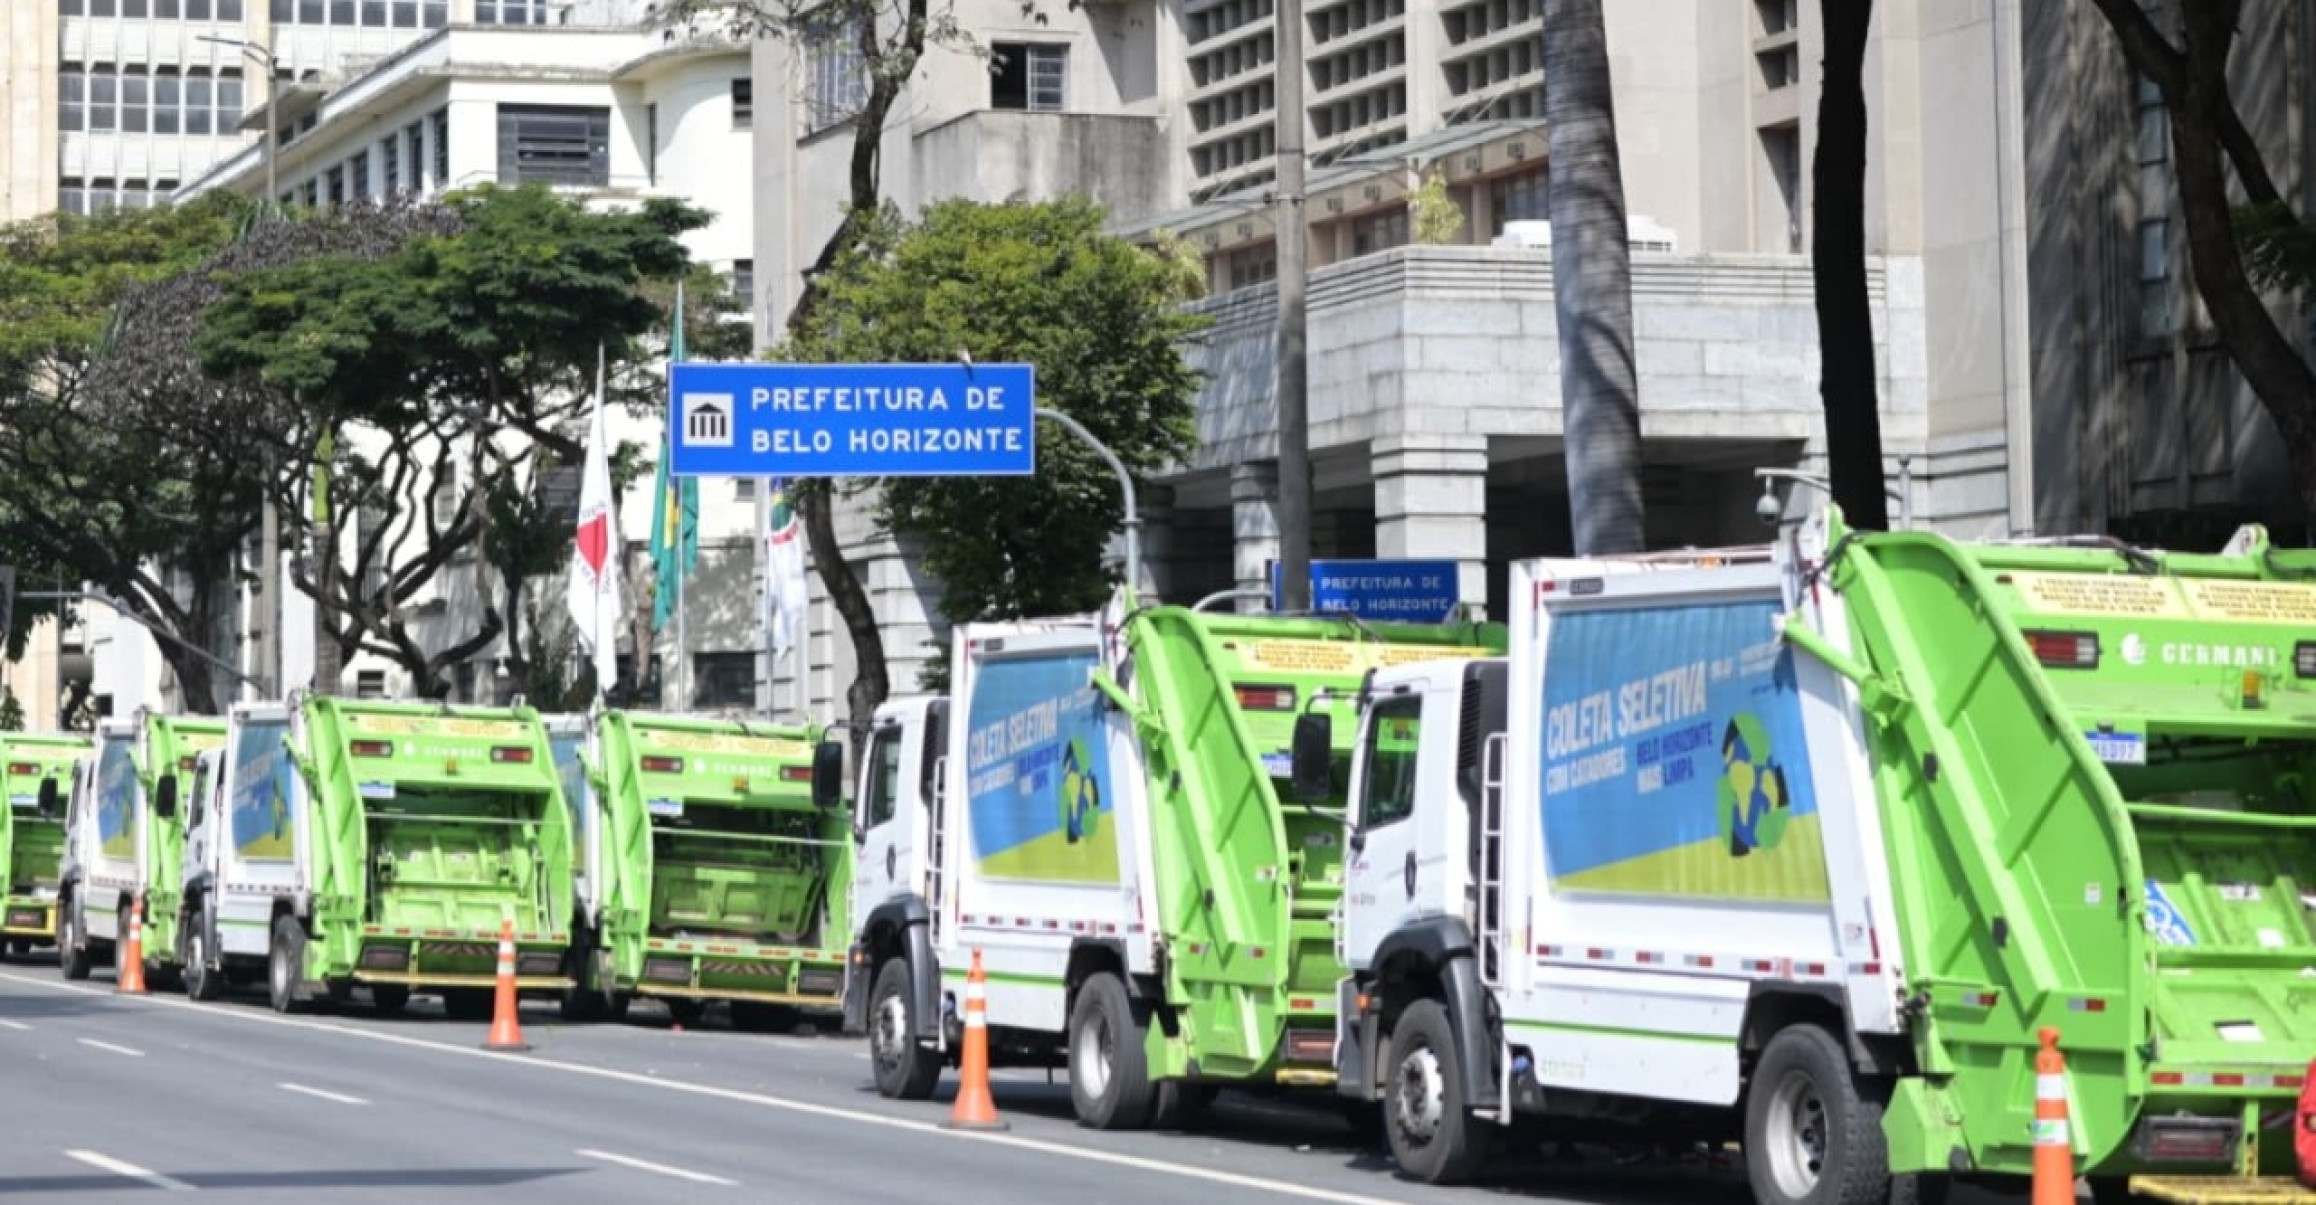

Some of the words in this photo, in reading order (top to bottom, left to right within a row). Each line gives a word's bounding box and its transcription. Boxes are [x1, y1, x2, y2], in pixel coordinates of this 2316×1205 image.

[751, 387, 948, 412] PREFEITURA
[966, 387, 1005, 411] DE
[751, 429, 832, 453] BELO
[849, 428, 1023, 452] HORIZONTE
[1320, 576, 1413, 590] PREFEITURA
[1422, 576, 1442, 589] DE
[1321, 598, 1360, 611] BELO
[1367, 598, 1449, 611] HORIZONTE
[2161, 642, 2277, 667] GERMANI
[1547, 689, 1614, 760] COLETA
[1617, 660, 1708, 737] SELETIVA
